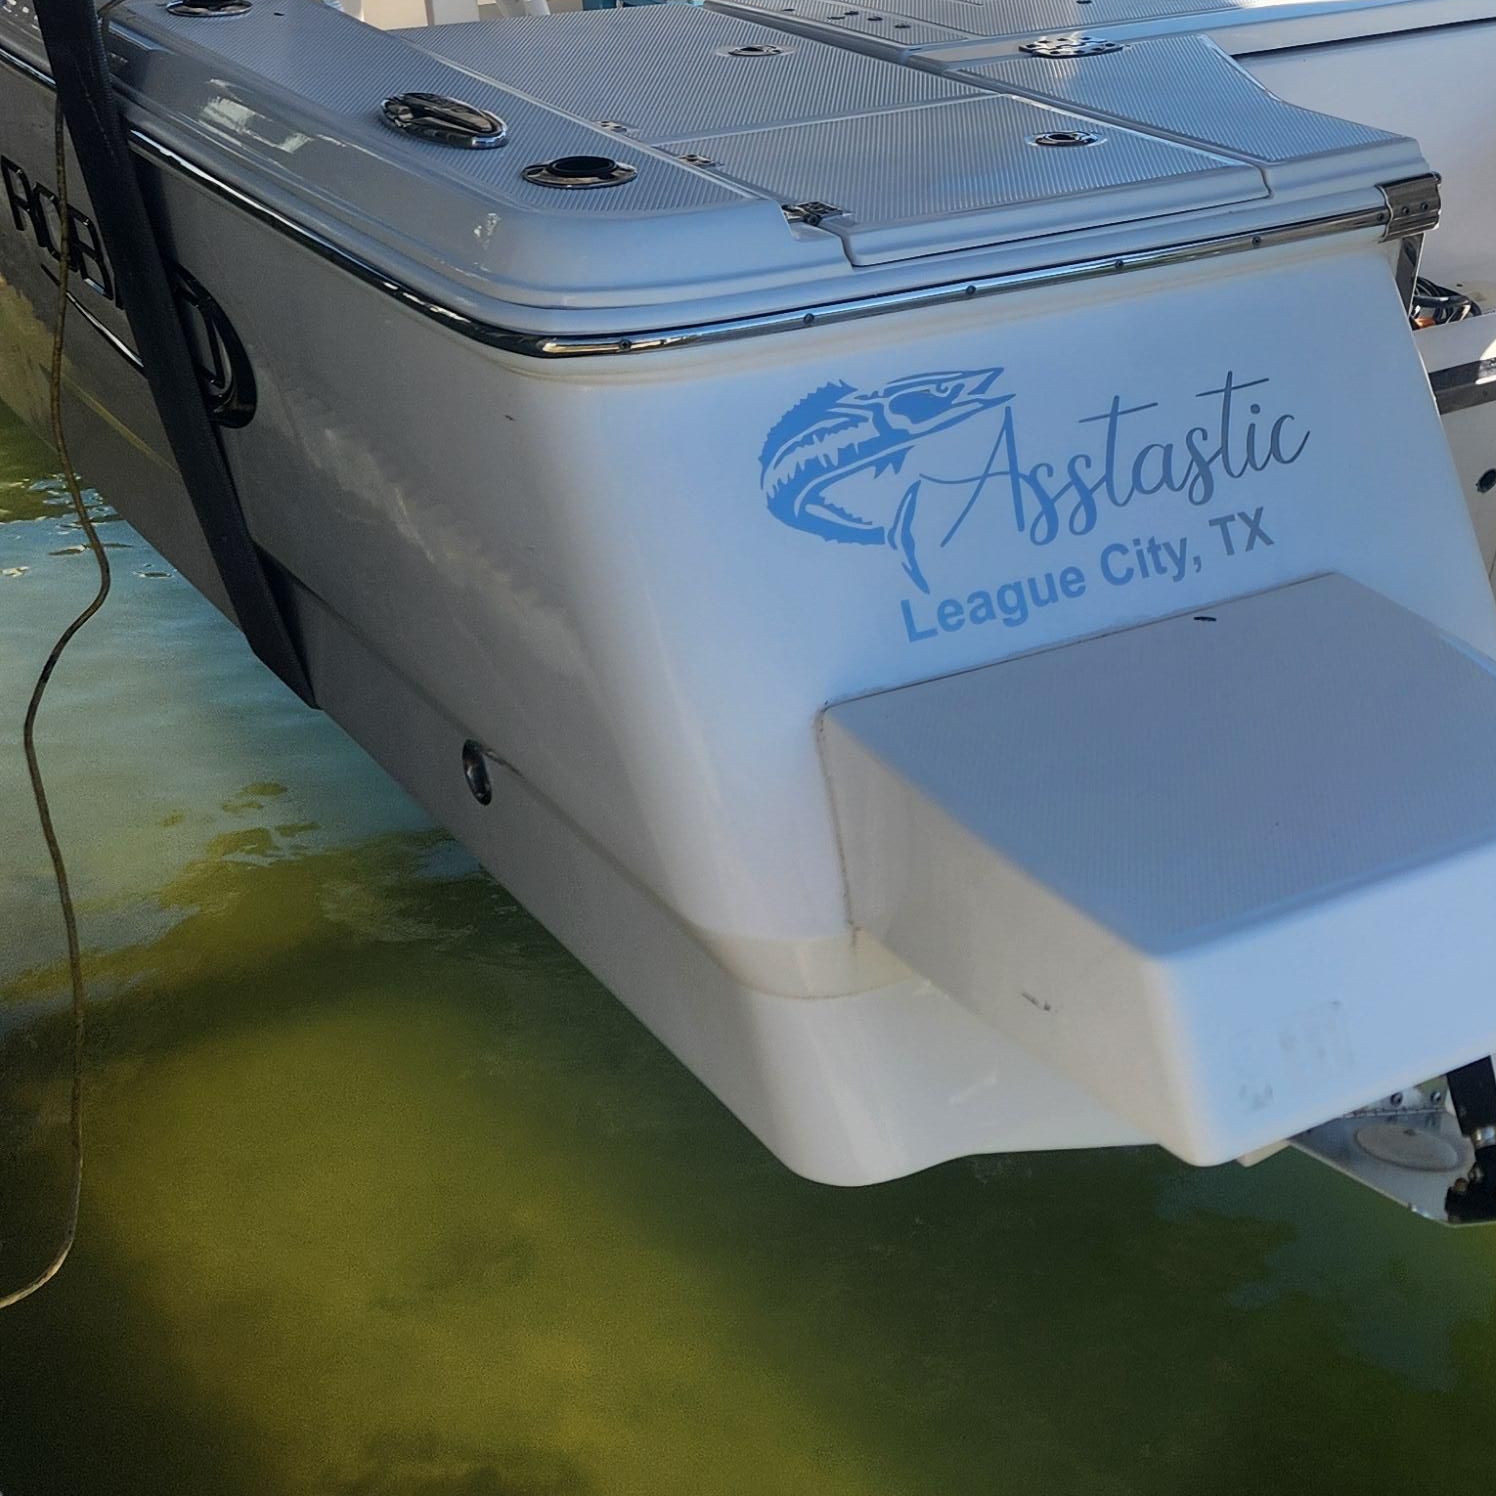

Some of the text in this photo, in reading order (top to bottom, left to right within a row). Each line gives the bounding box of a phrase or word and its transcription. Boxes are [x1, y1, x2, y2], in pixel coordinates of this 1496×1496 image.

[918, 370, 1310, 548] Asstastic
[900, 506, 1275, 642] League City, TX
